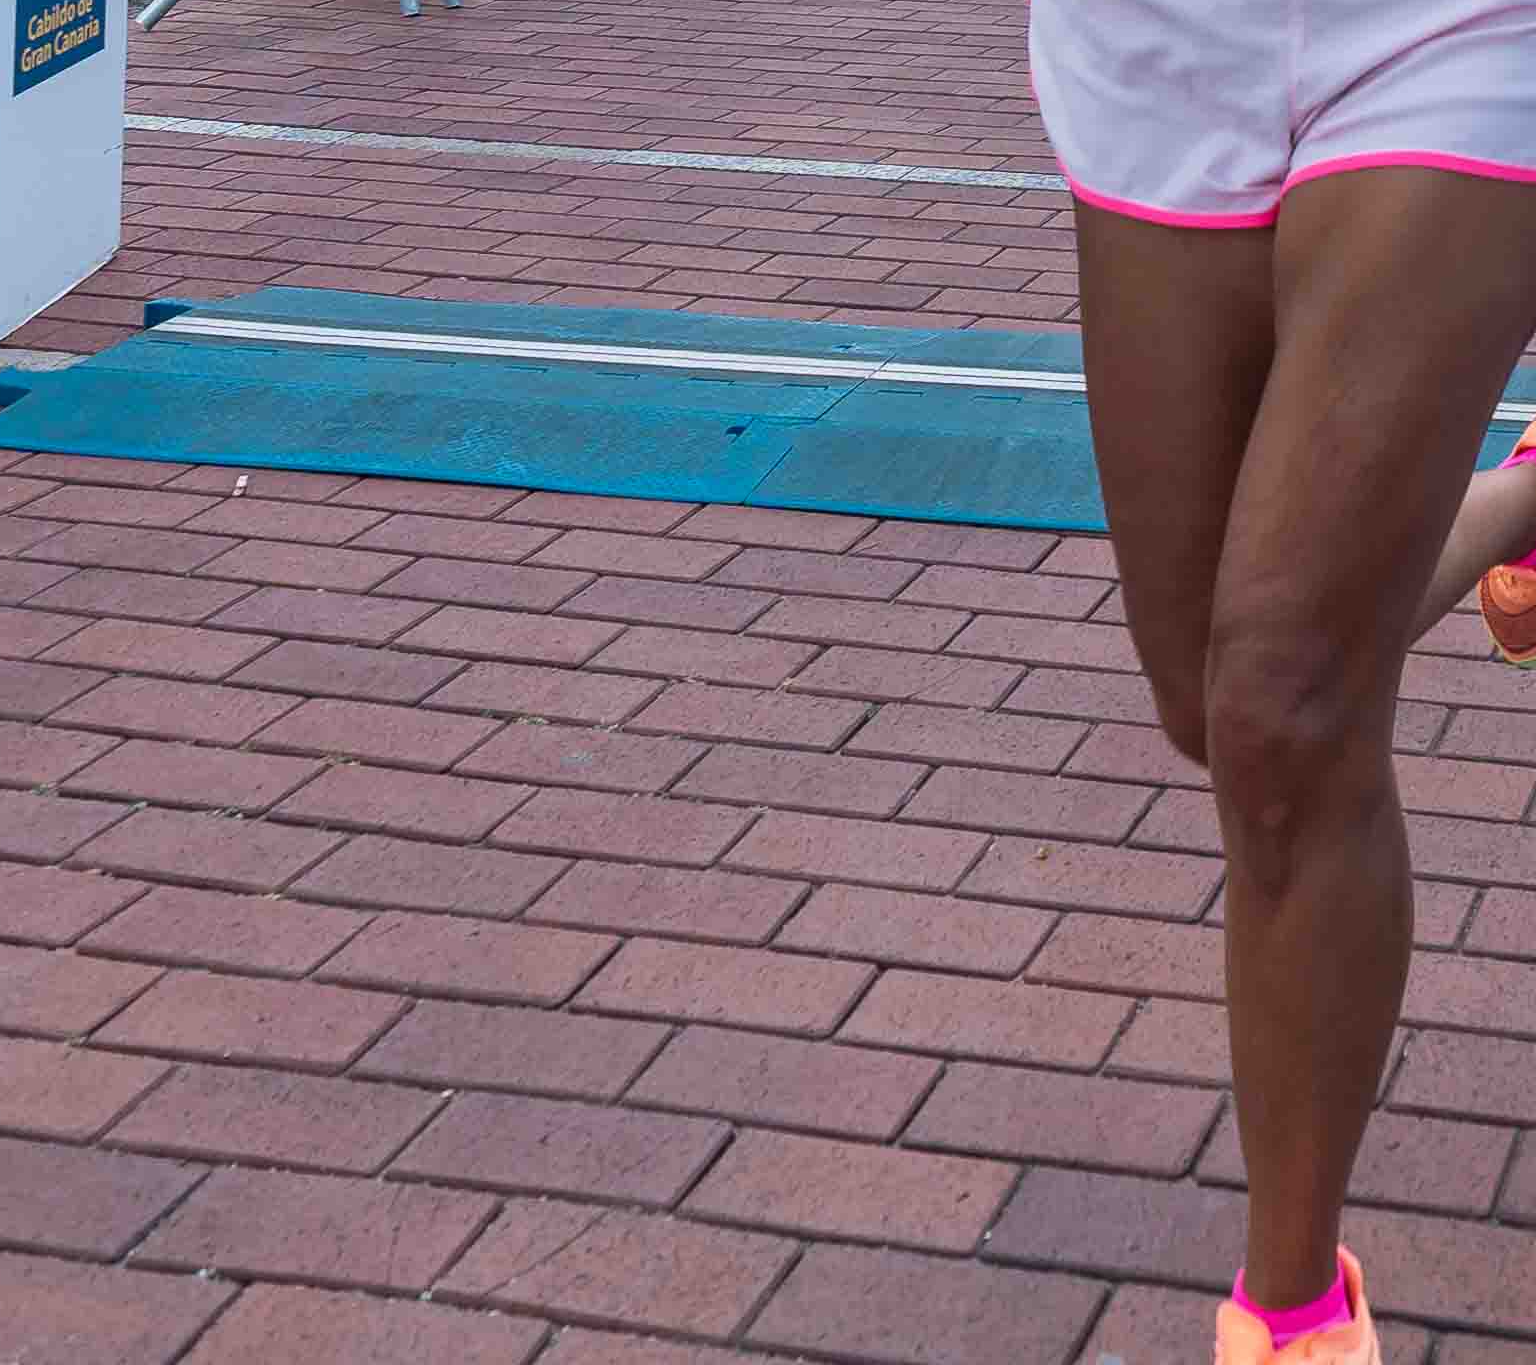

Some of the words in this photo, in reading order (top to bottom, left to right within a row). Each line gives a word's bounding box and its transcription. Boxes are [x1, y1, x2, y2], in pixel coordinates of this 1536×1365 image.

[20, 45, 52, 73] Gran
[54, 16, 100, 56] Canaria
[27, 8, 76, 42] Cabildo
